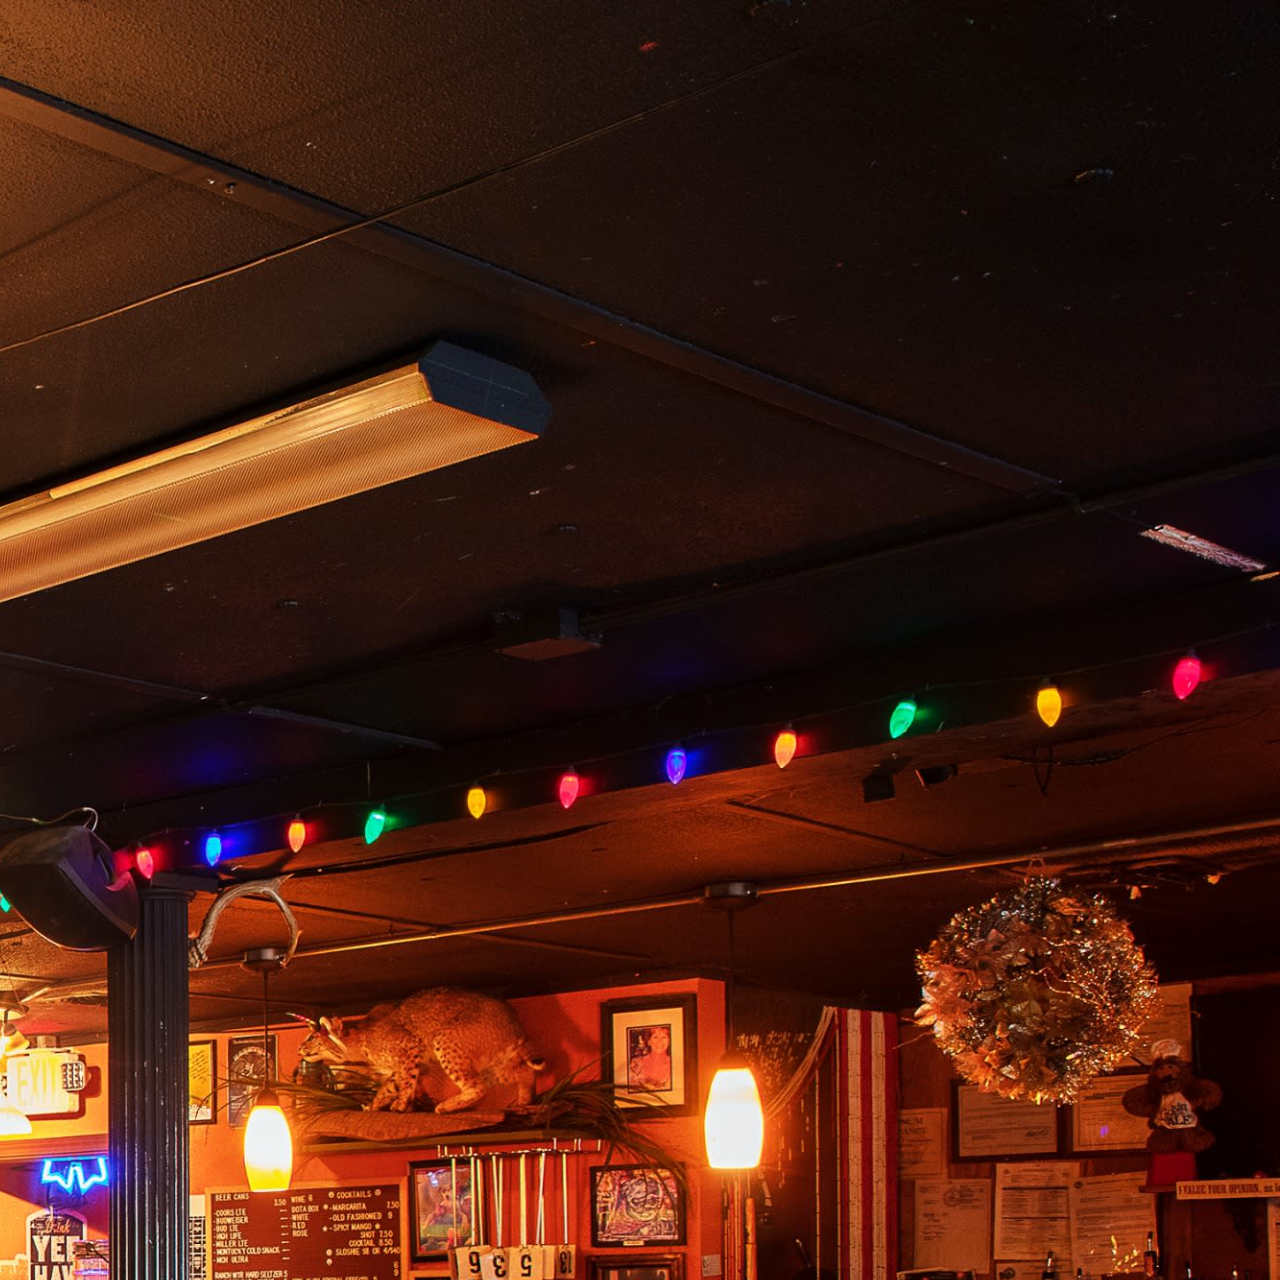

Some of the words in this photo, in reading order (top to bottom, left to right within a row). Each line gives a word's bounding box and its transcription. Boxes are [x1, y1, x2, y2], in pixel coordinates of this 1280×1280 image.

[17, 1059, 57, 1098] EXIT
[347, 1213, 382, 1221] FASHIONED
[45, 1218, 71, 1233] Drink
